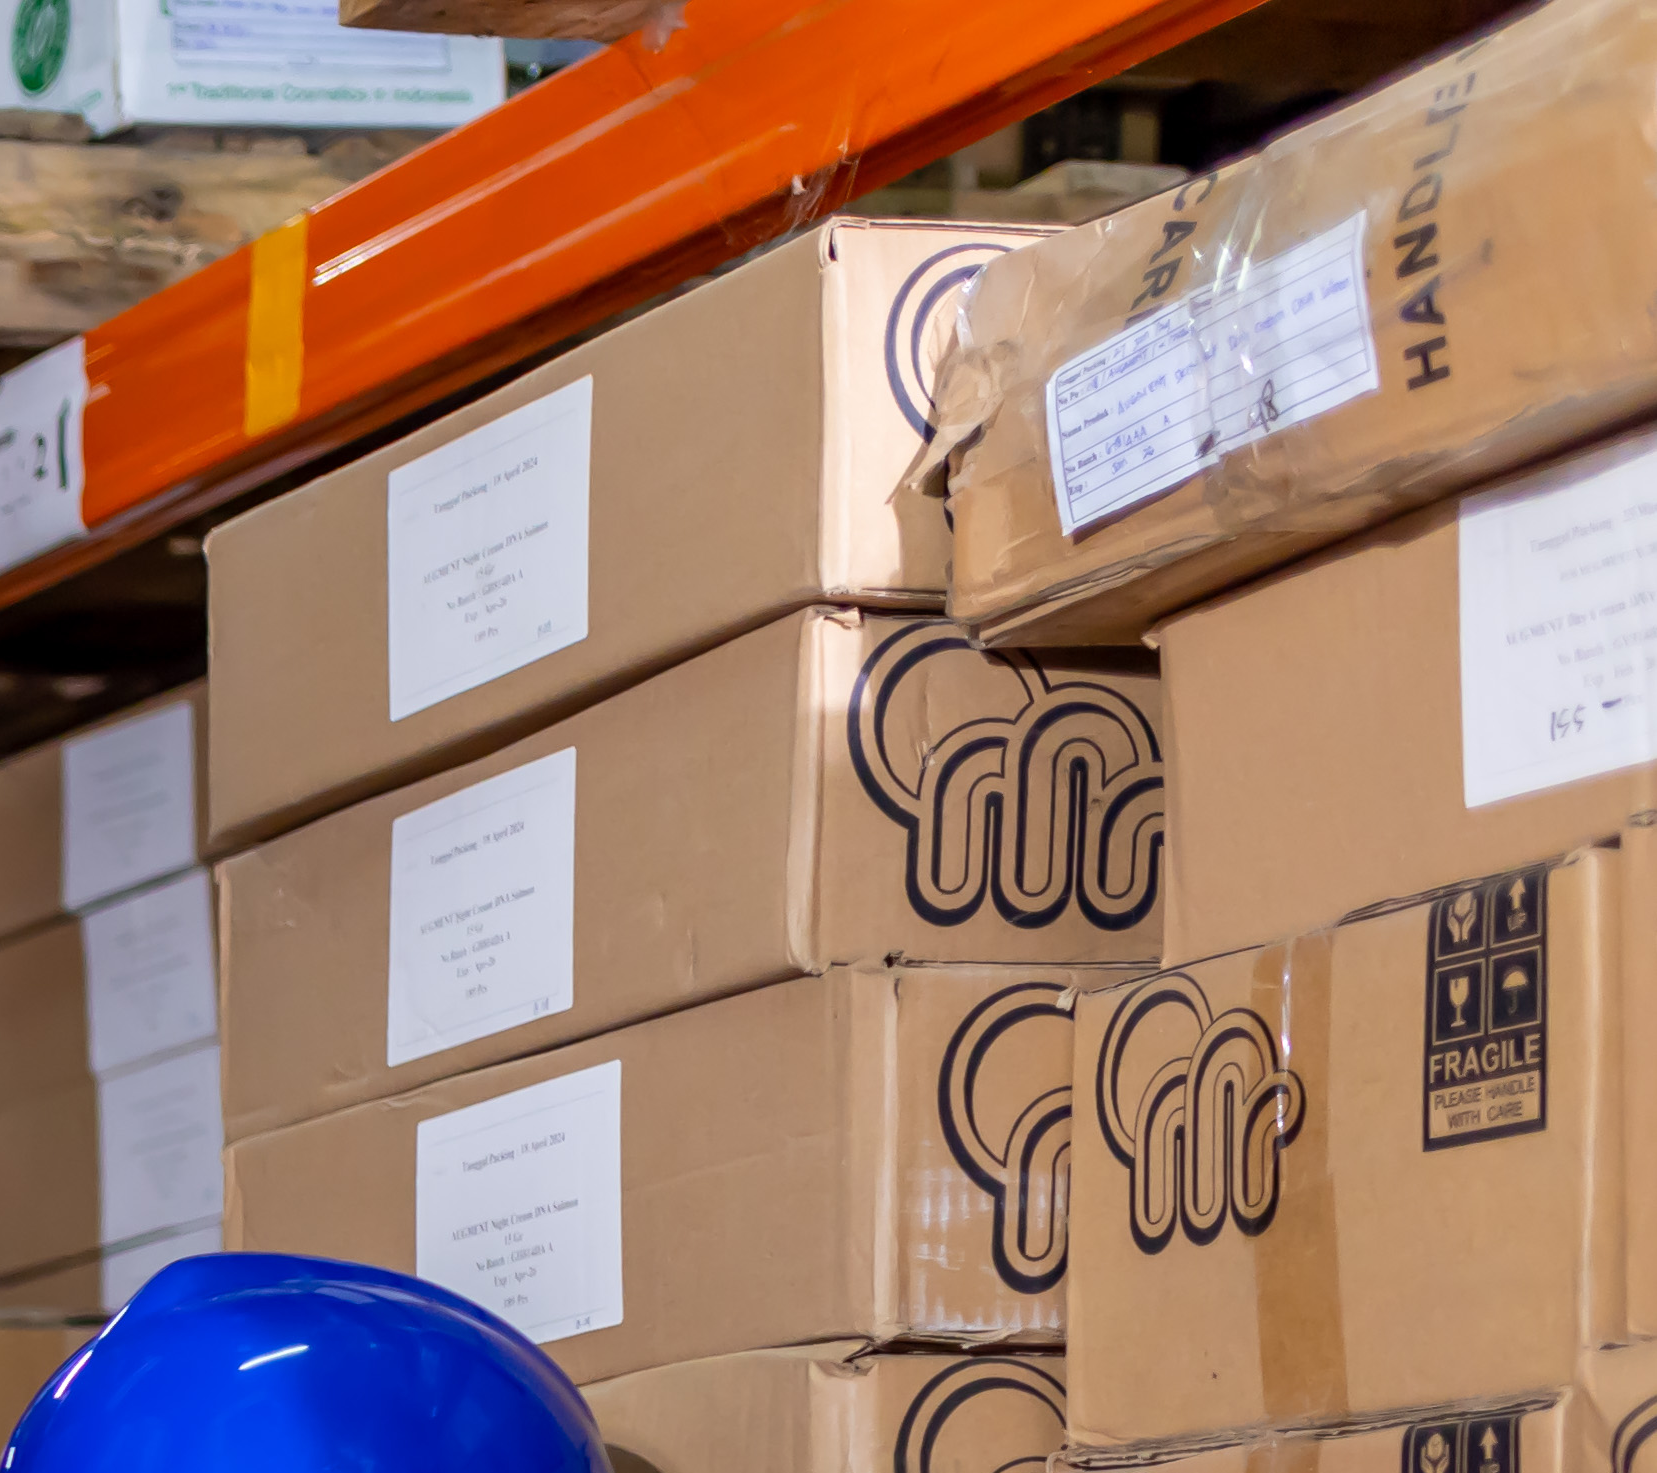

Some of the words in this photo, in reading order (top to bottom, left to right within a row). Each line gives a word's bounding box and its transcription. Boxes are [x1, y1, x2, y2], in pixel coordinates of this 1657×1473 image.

[1393, 70, 1475, 393] HANDLE
[1429, 1033, 1541, 1084] FRAGILE
[1434, 1086, 1482, 1111] PLEASE
[1487, 1075, 1535, 1100] HANDLE
[1447, 1110, 1480, 1130] WITH
[1486, 1101, 1523, 1123] CARE
